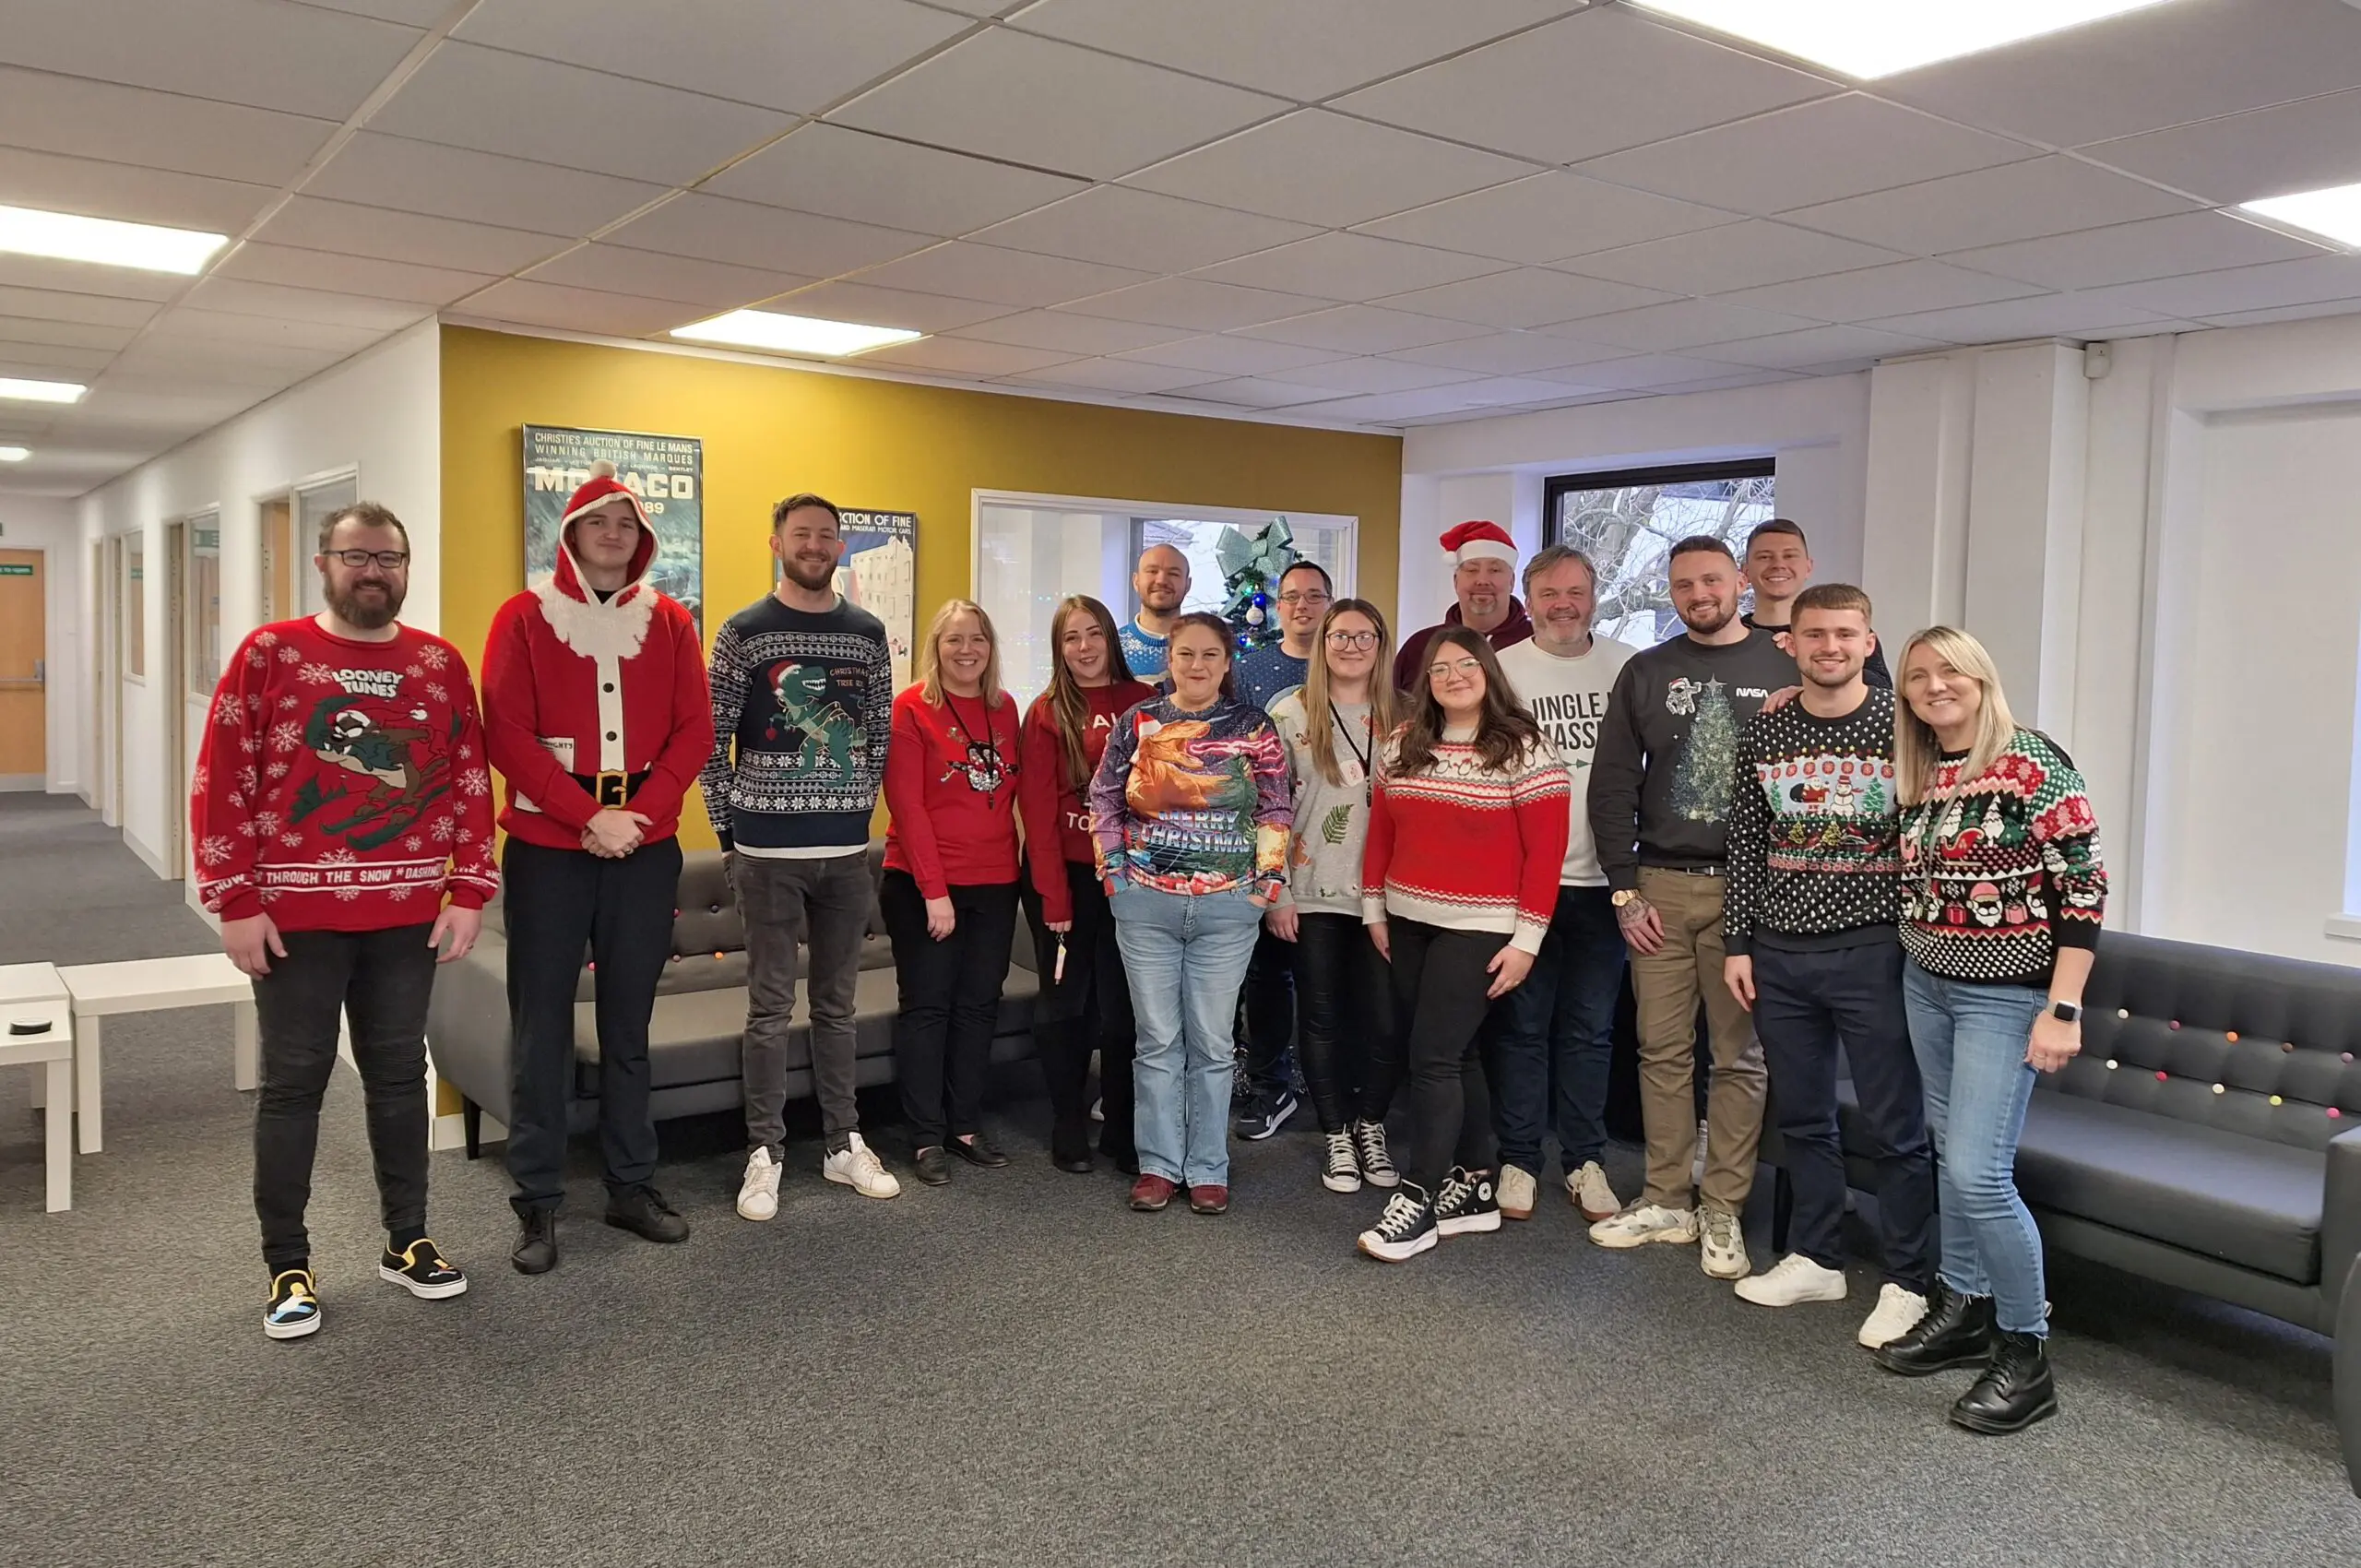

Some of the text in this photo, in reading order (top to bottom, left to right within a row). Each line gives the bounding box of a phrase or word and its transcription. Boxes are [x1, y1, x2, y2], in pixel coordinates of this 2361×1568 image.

[583, 436, 621, 448] AUCTION
[623, 438, 635, 449] OF
[636, 439, 656, 451] FINE
[657, 441, 667, 452] LE
[668, 442, 694, 454] MANS
[535, 445, 694, 465] WINNING BRITISH MARQUES
[534, 465, 694, 500] MOACO
[839, 512, 912, 528] CTION OF FINE
[332, 669, 404, 684] LOONEY
[836, 679, 854, 687] TREE
[340, 681, 397, 698] TUNES
[1736, 687, 1769, 698] NASA
[1158, 811, 1240, 830] MERRY
[1142, 823, 1250, 853] CHRISTMAS
[206, 873, 244, 897] SNOW
[266, 871, 319, 885] THROUGH
[325, 871, 351, 883] THE
[359, 869, 391, 883] SNOW
